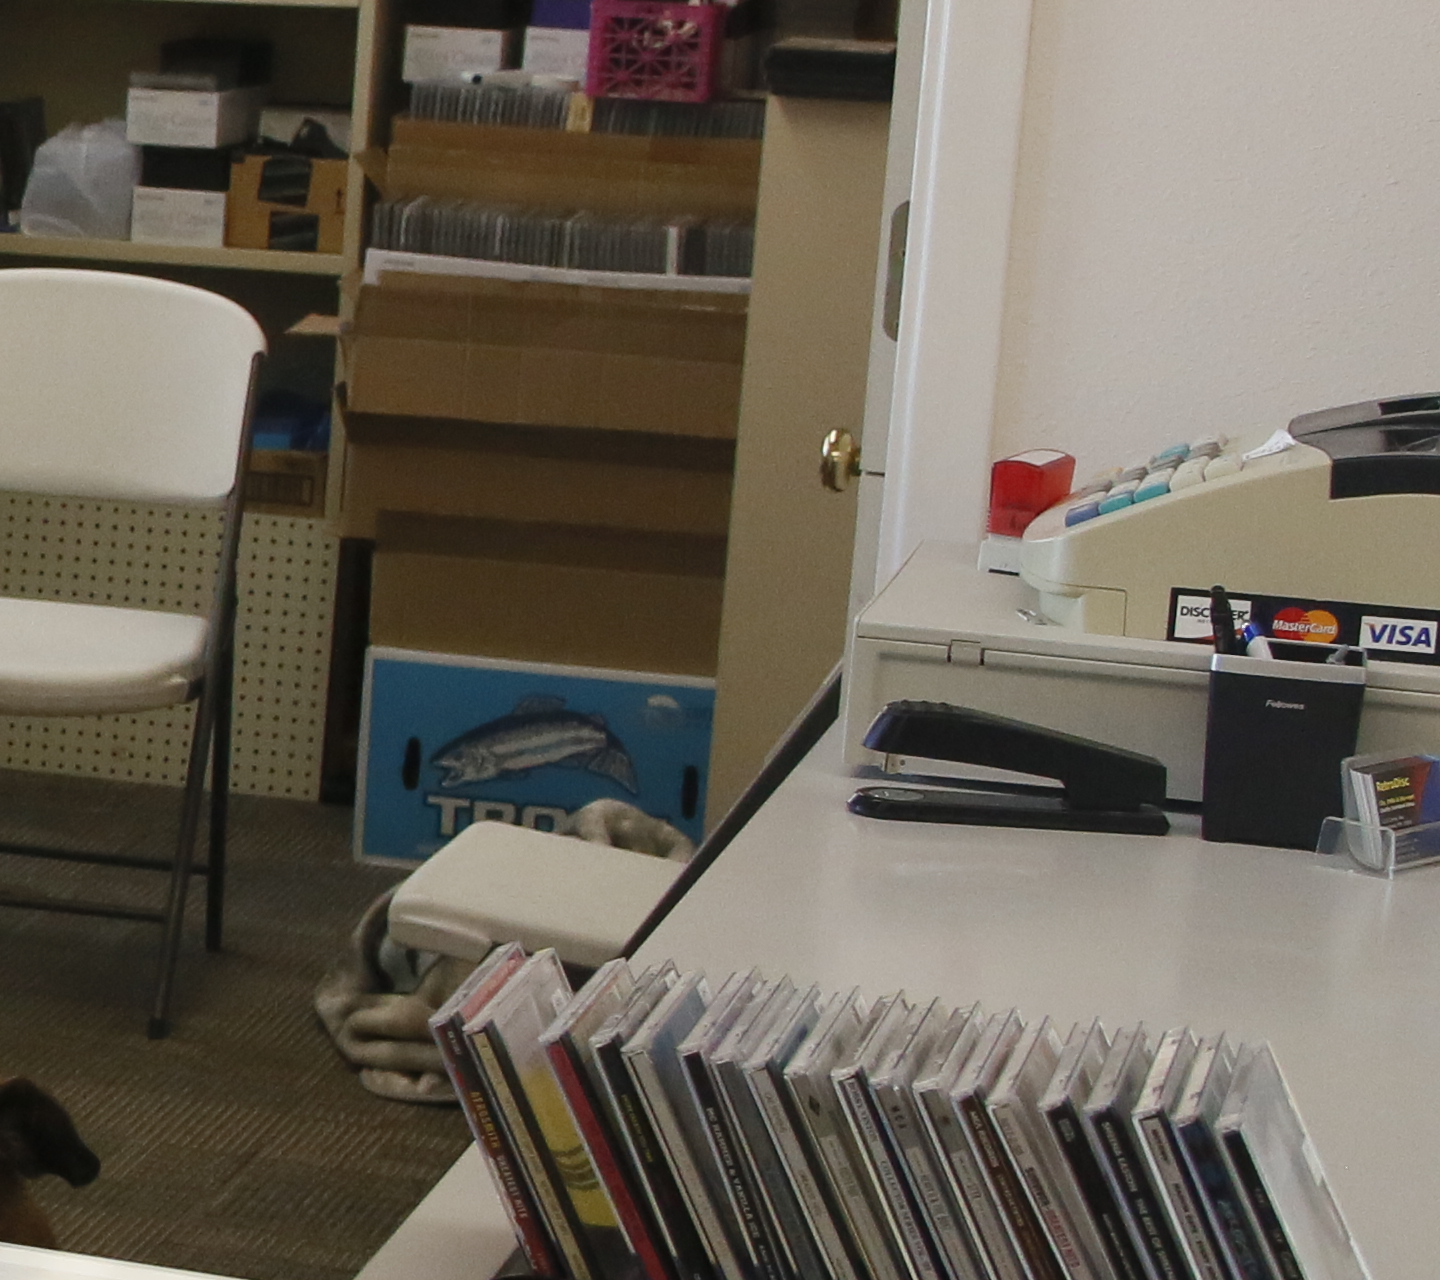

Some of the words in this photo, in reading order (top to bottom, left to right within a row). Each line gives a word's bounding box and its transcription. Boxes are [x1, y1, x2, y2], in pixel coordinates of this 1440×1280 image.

[1179, 605, 1249, 622] DISCER
[1272, 619, 1336, 636] MasterCard
[1364, 622, 1433, 648] VISA
[1264, 697, 1306, 711] Fellowes
[1115, 1155, 1139, 1193] EASTON
[731, 1176, 754, 1221] VANILLA
